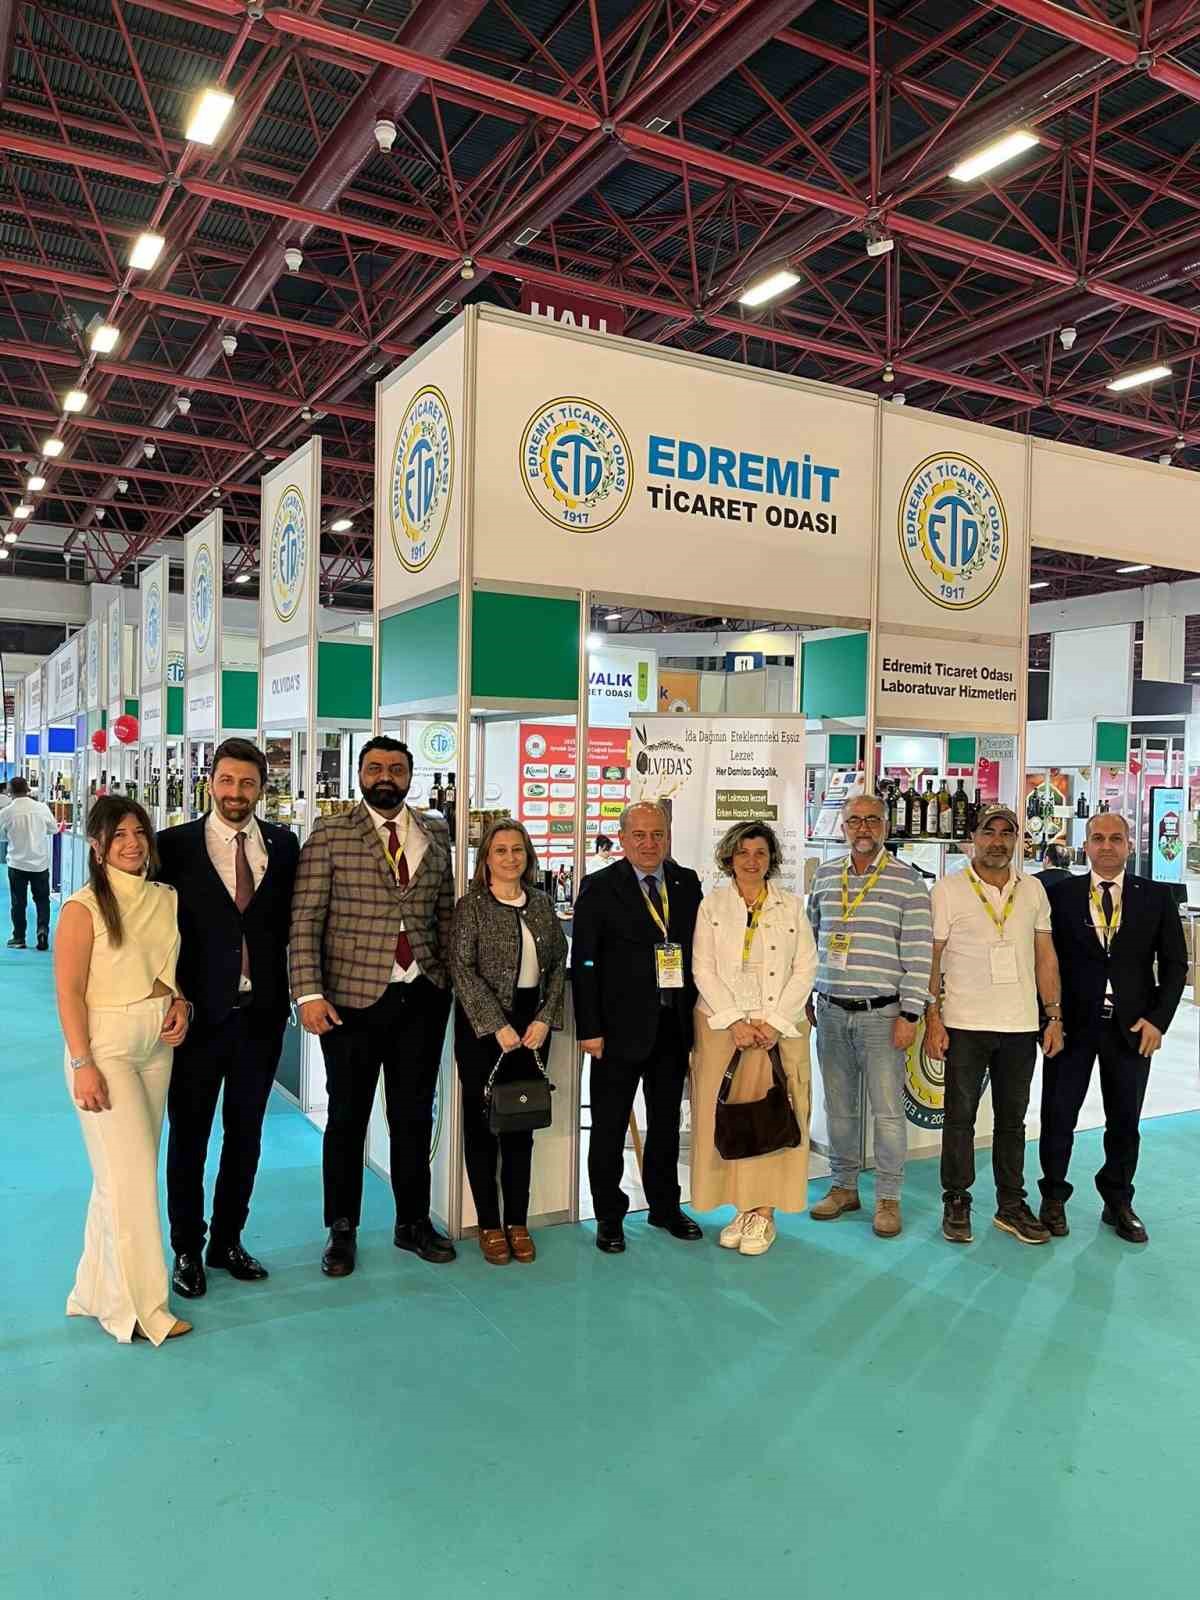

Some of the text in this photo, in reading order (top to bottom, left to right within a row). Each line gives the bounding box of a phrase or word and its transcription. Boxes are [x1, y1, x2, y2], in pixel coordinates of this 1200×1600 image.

[528, 404, 626, 493] EDREMİT TİCARET ODASI
[648, 434, 840, 503] EDREMİT
[562, 510, 590, 524] 1917
[646, 483, 837, 535] TİCARET ODASI
[906, 461, 1001, 562] EDREMİT TİCARET ODASI
[411, 541, 426, 561] 1917
[939, 584, 965, 600] 1917
[882, 658, 1013, 682] Edremit Ticaret Odası
[605, 688, 632, 698] ODASI
[881, 678, 1017, 702] Laboratuvar Hizmetleri
